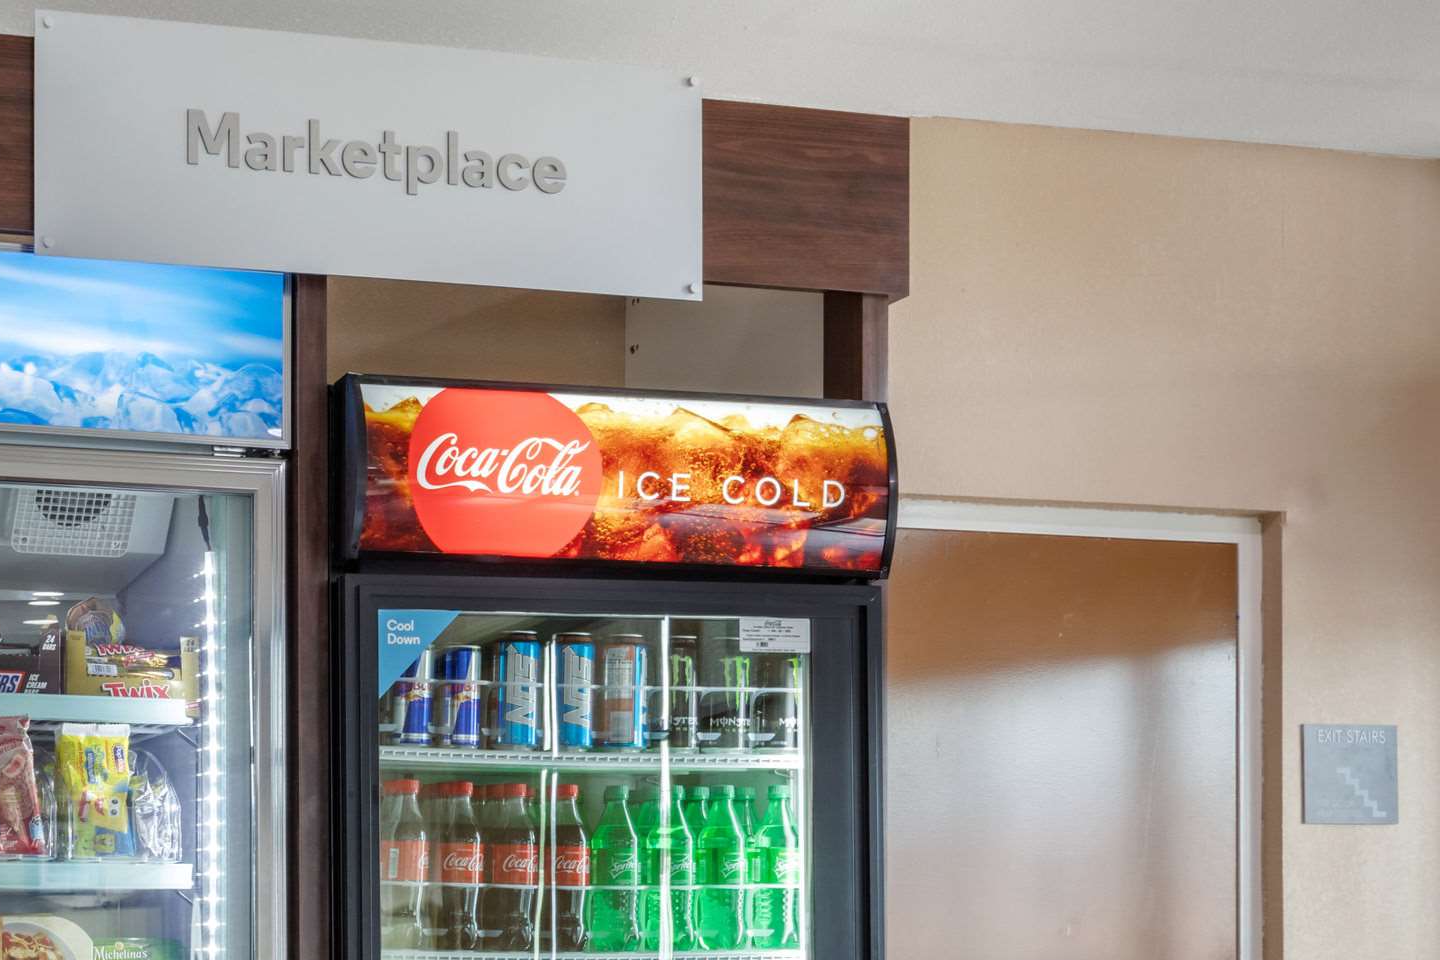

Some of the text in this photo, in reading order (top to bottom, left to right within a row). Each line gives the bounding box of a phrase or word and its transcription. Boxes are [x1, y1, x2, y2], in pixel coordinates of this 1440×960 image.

[185, 107, 569, 196] Marketplace
[416, 431, 592, 497] Coca-Cola
[616, 470, 847, 509] ICE COLD
[386, 619, 415, 632] Cool
[386, 633, 421, 645] Down
[1317, 728, 1387, 744] EXIT STAIRS
